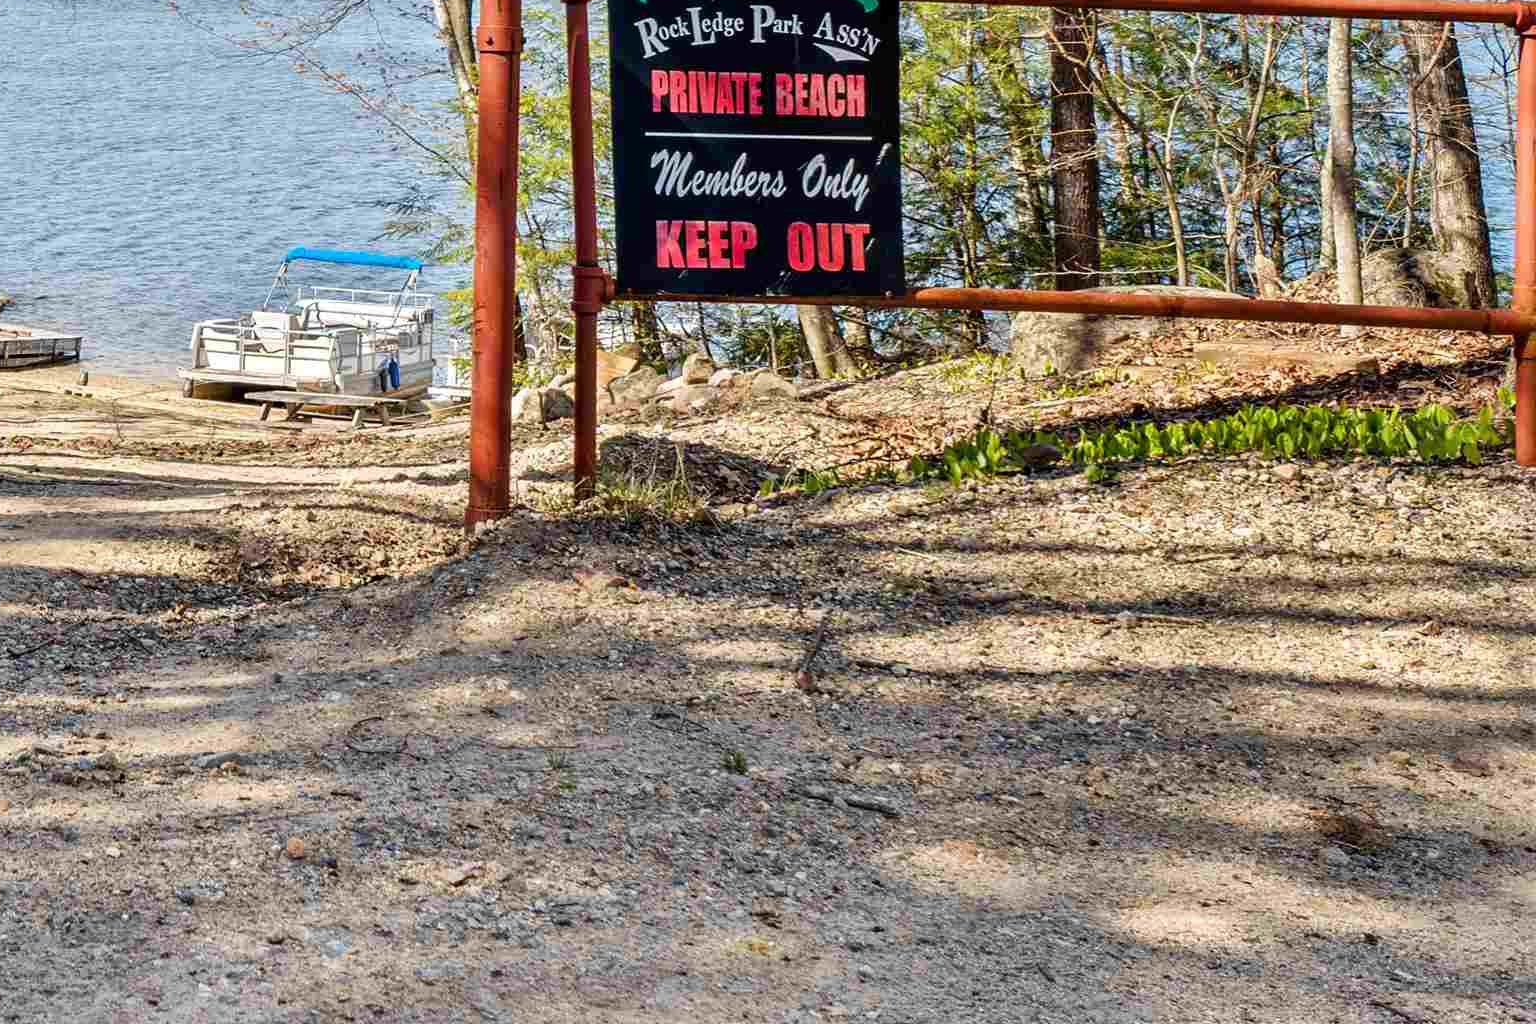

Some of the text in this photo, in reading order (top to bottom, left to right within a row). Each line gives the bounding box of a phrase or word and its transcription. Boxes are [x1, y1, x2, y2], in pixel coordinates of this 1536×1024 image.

[750, 4, 804, 43] Park
[651, 70, 866, 118] PRIVATE BEACH
[650, 149, 870, 212] Members Only
[655, 220, 871, 272] KEEP OUT
